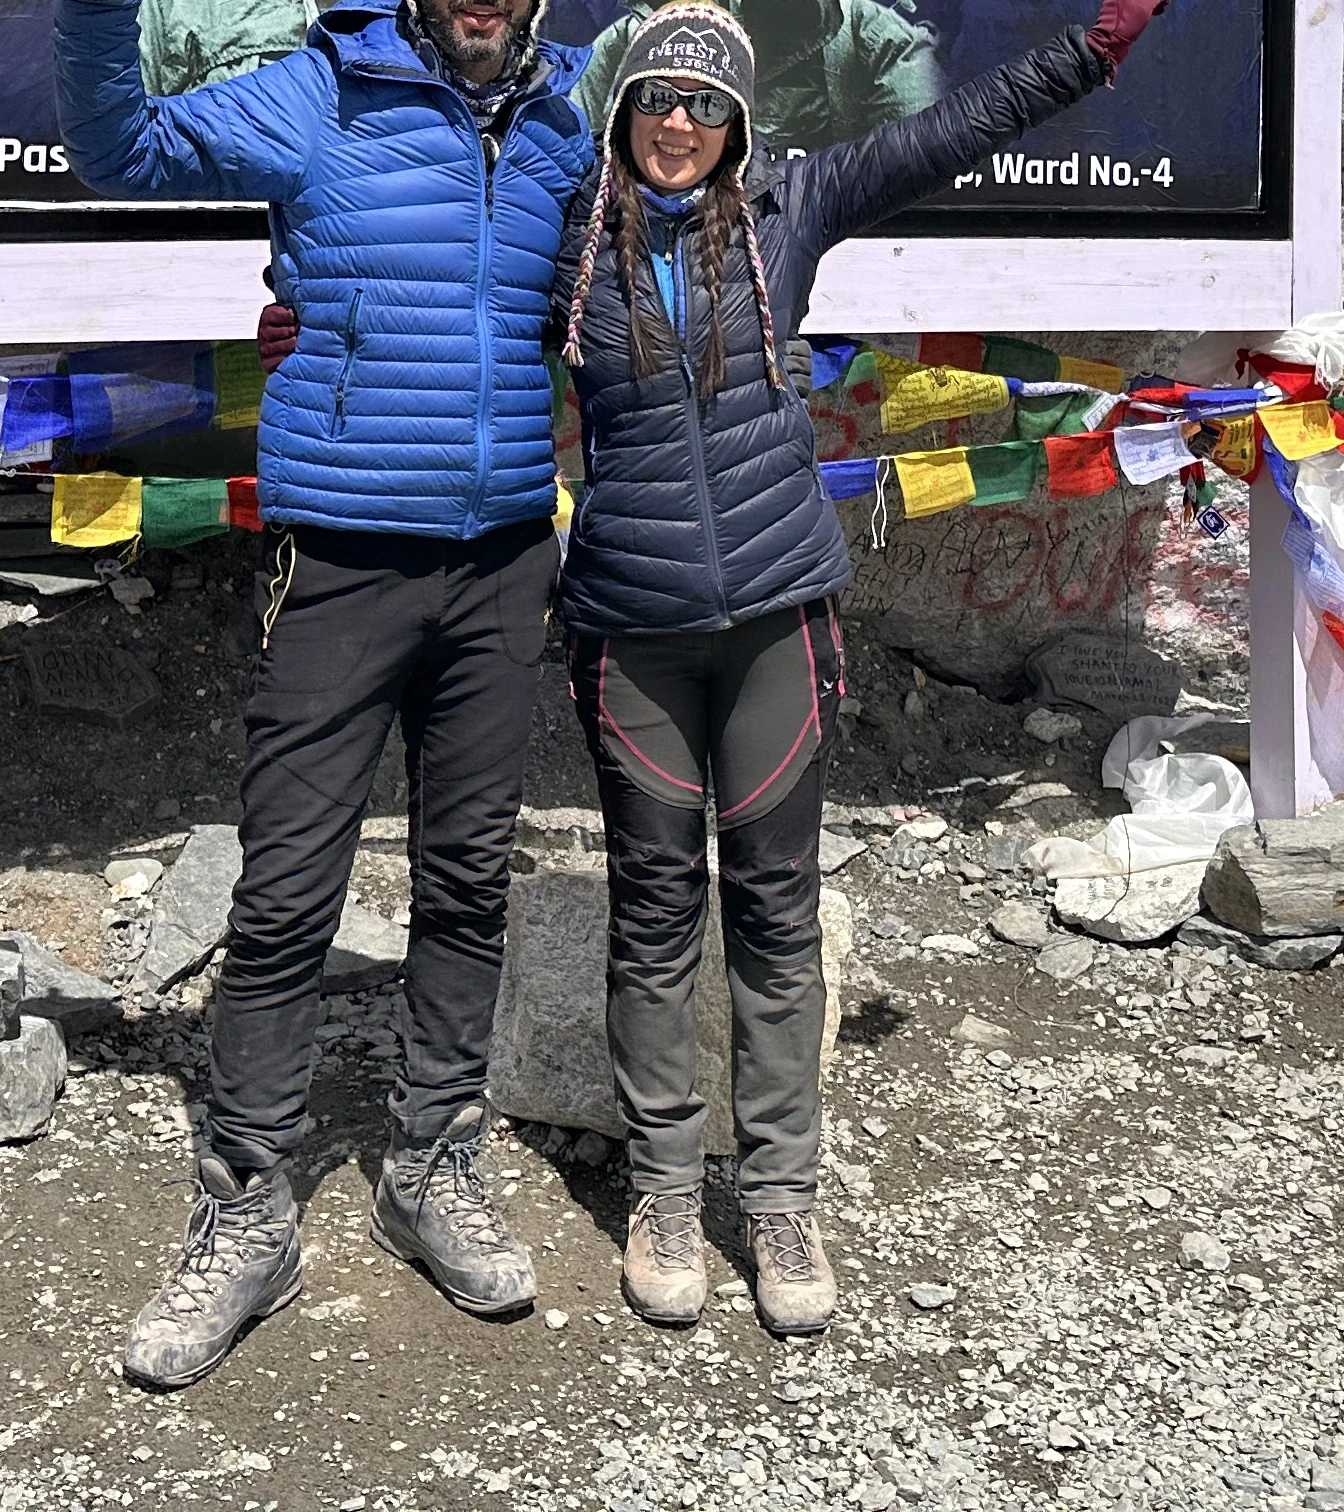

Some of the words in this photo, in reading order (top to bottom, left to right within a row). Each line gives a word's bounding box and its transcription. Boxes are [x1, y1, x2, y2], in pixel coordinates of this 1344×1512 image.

[647, 42, 718, 61] EVEREST
[672, 56, 724, 78] 5365M
[992, 152, 1079, 185] Ward
[1090, 155, 1174, 188] No.-4
